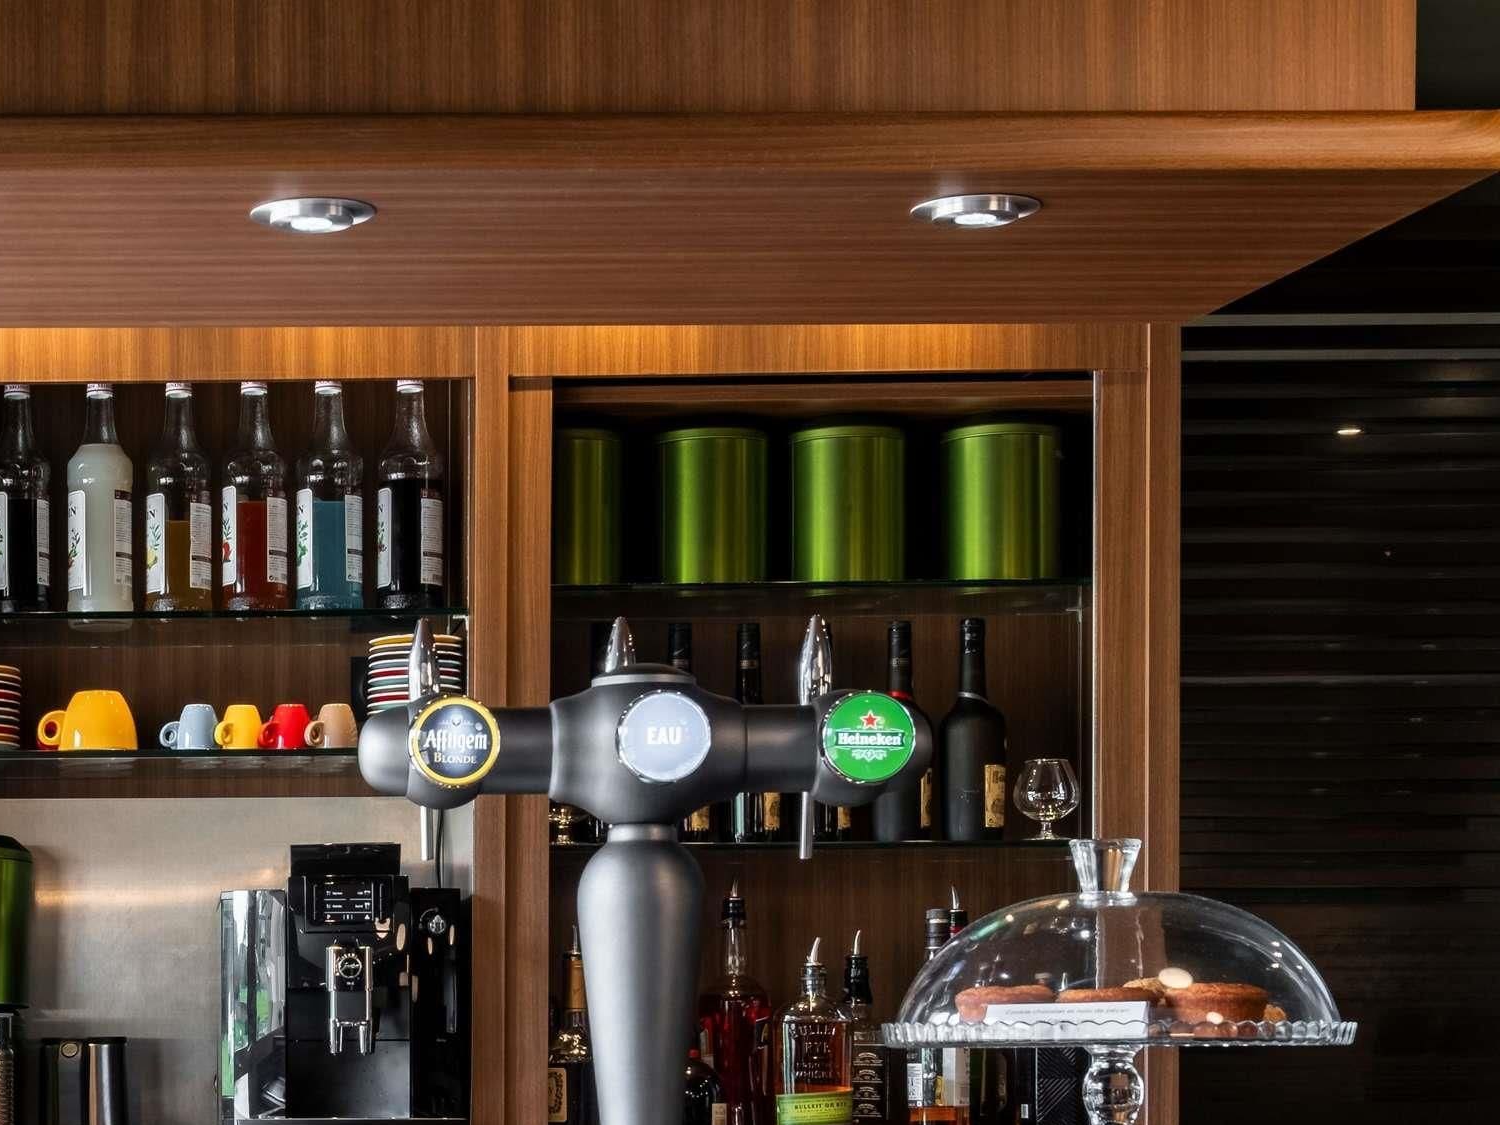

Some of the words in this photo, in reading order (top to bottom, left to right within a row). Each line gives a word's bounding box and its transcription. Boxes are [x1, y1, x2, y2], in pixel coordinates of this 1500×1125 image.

[423, 729, 487, 753] Affligem
[647, 726, 682, 745] EAU
[837, 732, 902, 746] Heineken
